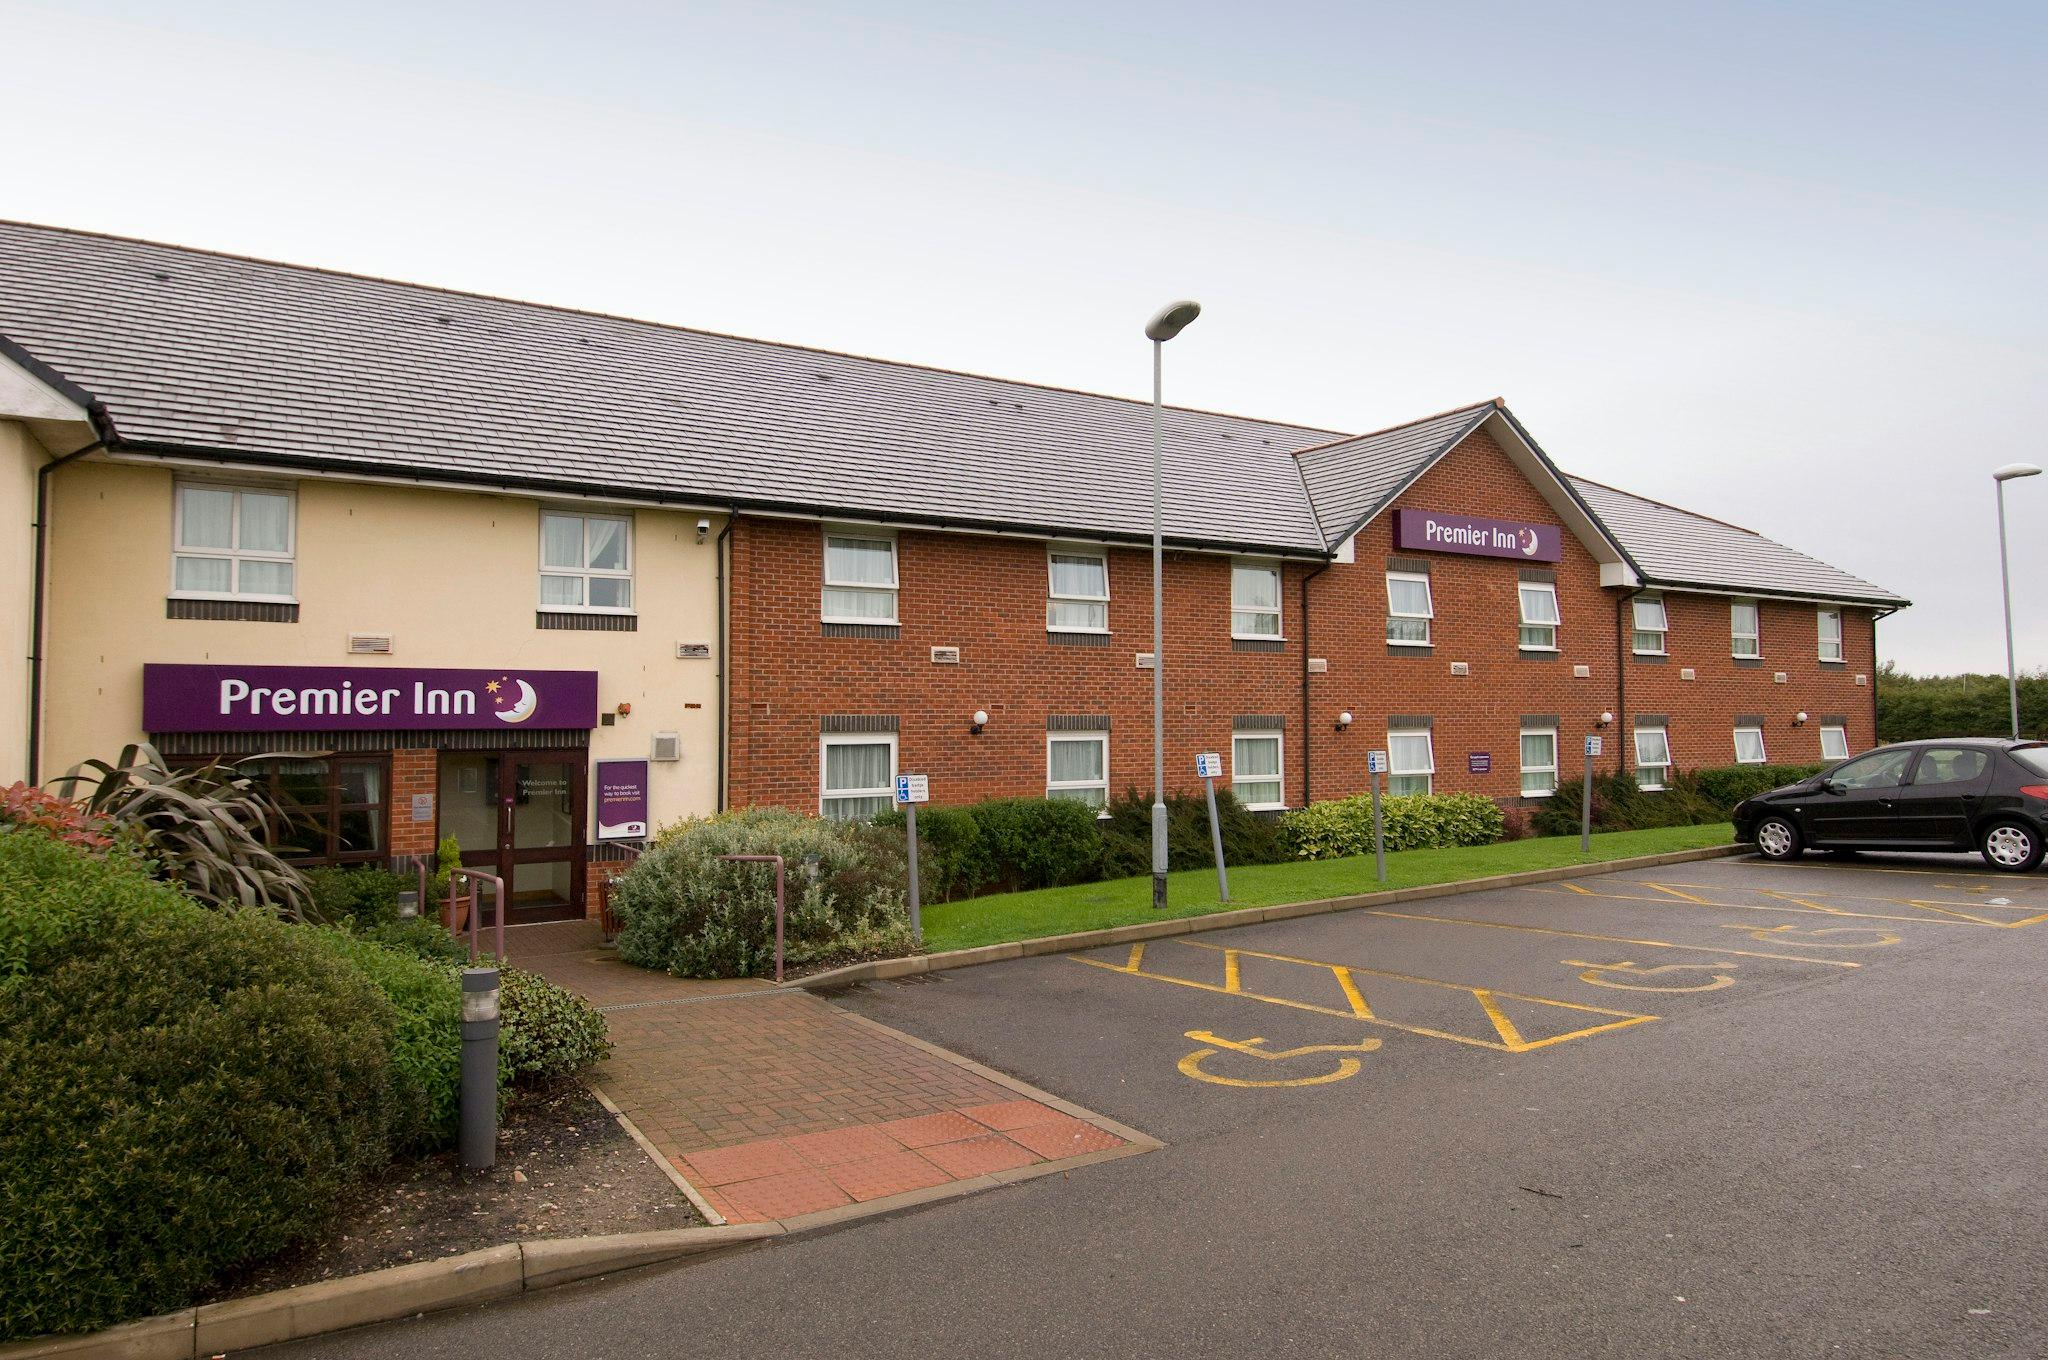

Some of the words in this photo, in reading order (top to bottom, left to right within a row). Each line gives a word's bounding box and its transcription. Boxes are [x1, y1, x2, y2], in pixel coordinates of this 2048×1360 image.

[1426, 520, 1488, 546] Premier
[1493, 527, 1516, 549] Inn
[219, 678, 401, 715] Premier
[414, 681, 476, 715] Inn
[522, 779, 558, 787] Welcome
[522, 788, 553, 796] Premier
